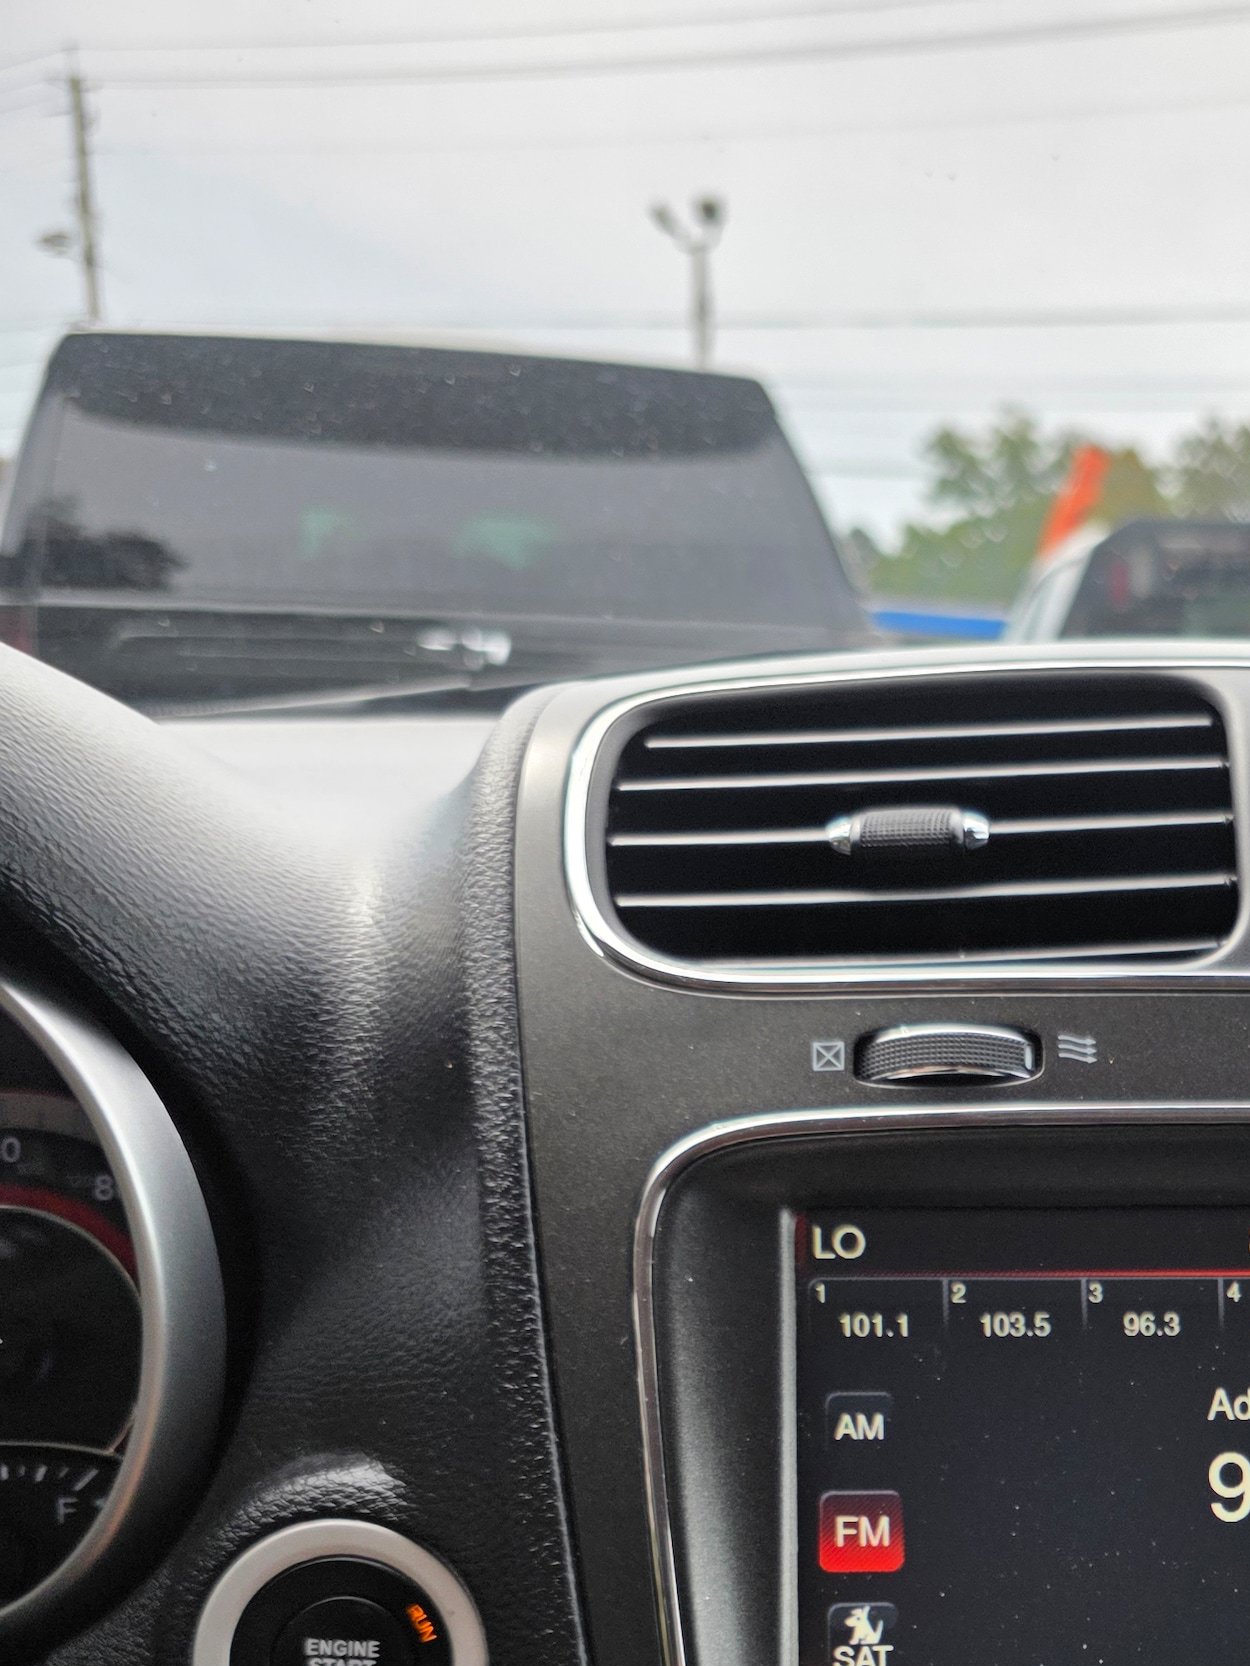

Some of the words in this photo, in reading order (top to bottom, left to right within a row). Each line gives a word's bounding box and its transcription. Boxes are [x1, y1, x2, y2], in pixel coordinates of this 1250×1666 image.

[813, 1225, 866, 1259] LO
[816, 1284, 825, 1303] 1
[952, 1283, 966, 1303] 2
[1089, 1283, 1103, 1303] 3
[1227, 1282, 1241, 1302] 4
[840, 1313, 908, 1337] 101.1
[981, 1312, 1051, 1337] 103.5
[1124, 1312, 1180, 1336] 96.3
[835, 1413, 884, 1440] AM
[56, 1497, 78, 1523] F
[835, 1516, 890, 1547] FM
[406, 1604, 438, 1643] RUN
[305, 1639, 380, 1658] ENGINE
